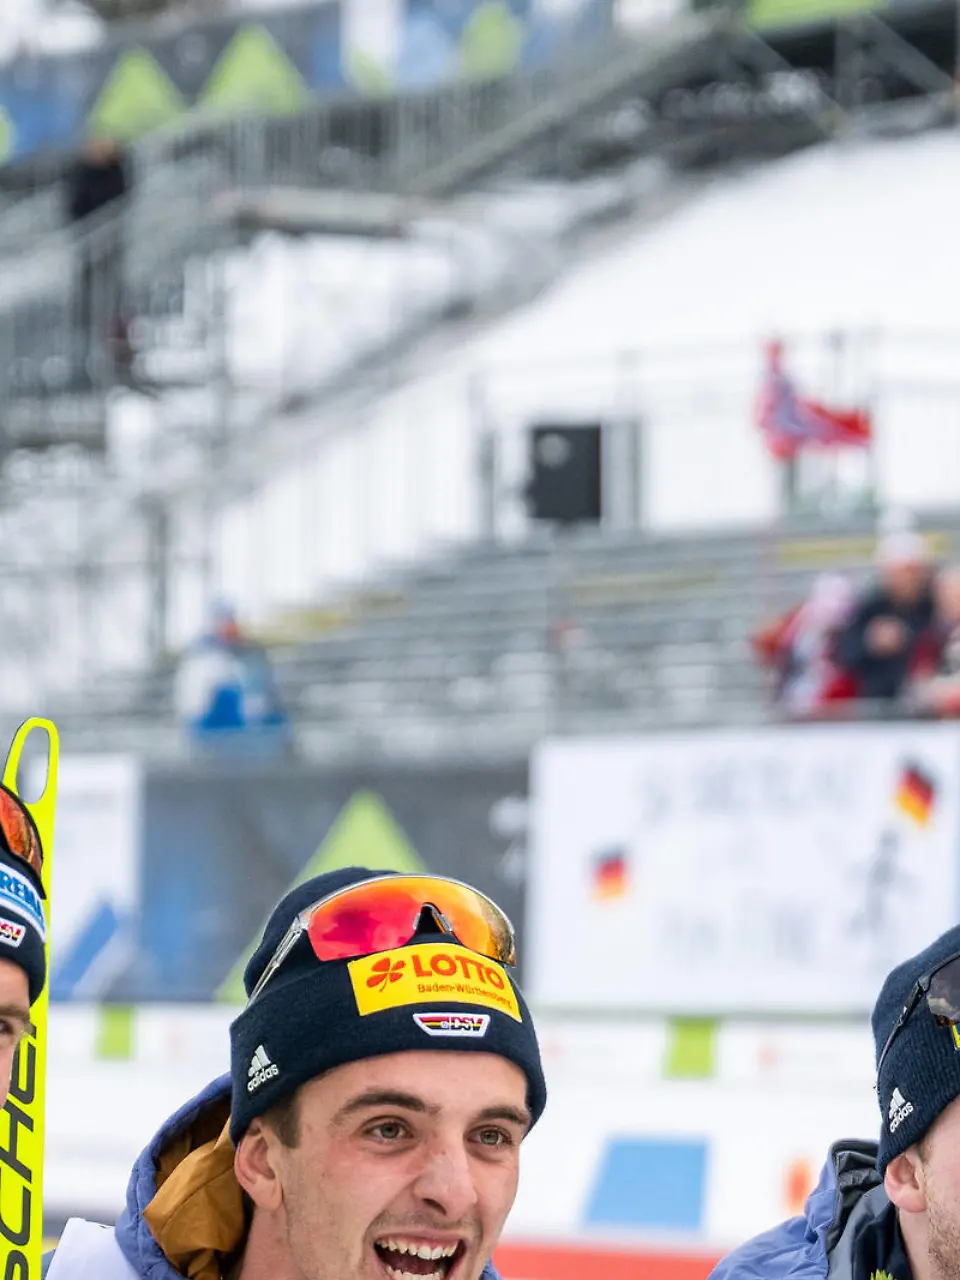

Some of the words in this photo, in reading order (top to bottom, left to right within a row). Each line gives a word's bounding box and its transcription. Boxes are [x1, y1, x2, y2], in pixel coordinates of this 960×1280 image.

[412, 953, 505, 990] LOTTO
[449, 1016, 484, 1032] DSV
[247, 1064, 279, 1093] adidas
[889, 1101, 914, 1132] adidas
